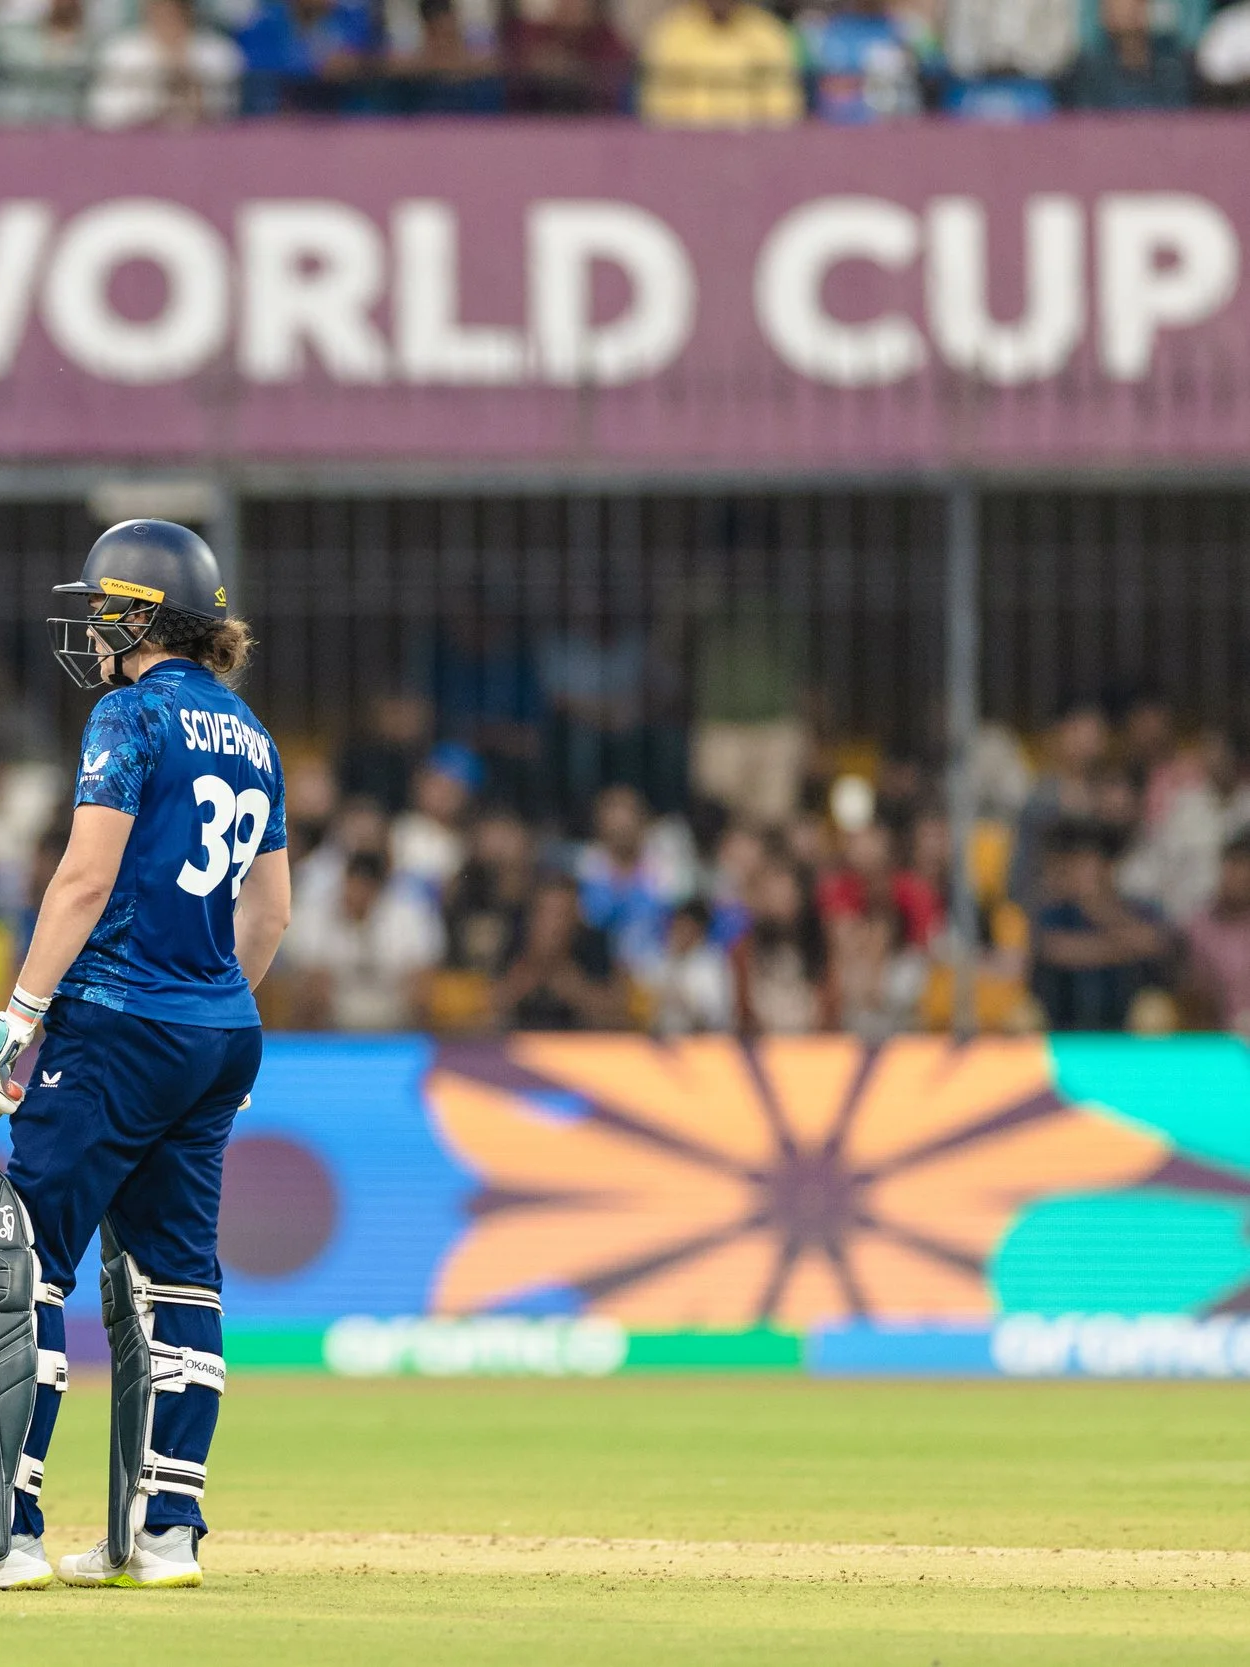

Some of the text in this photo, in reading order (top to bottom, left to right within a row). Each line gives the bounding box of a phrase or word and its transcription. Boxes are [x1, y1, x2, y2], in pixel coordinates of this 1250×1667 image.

[755, 192, 1241, 387] CUP
[110, 582, 144, 594] MASURI
[176, 775, 270, 900] 39
